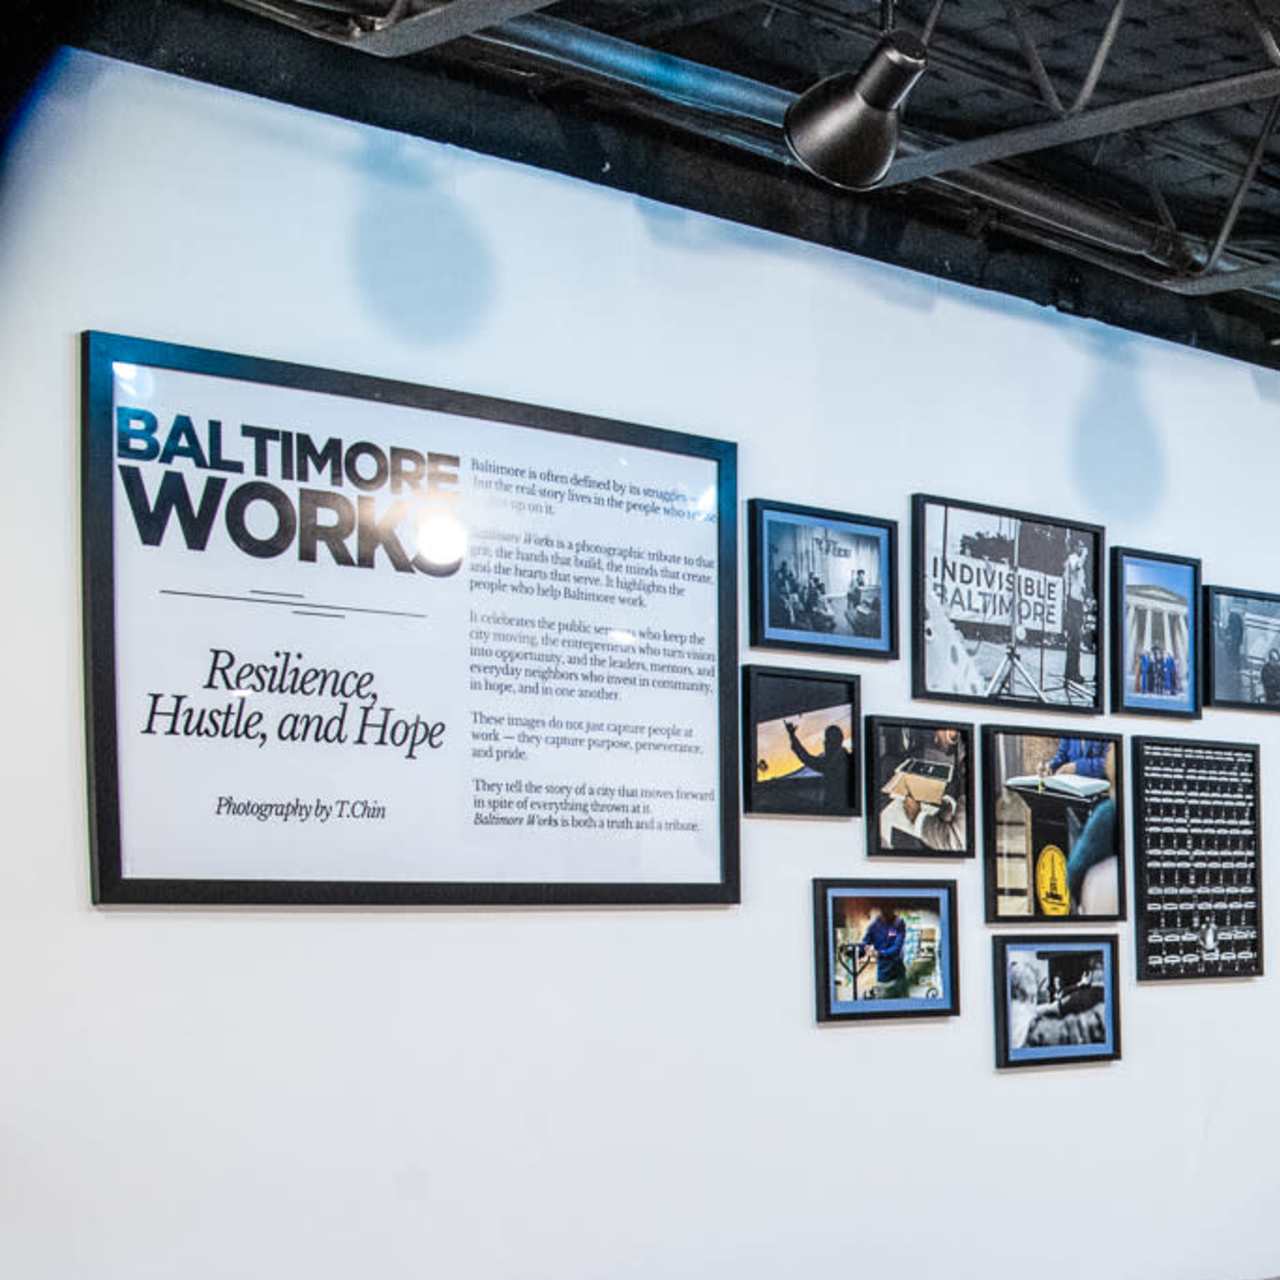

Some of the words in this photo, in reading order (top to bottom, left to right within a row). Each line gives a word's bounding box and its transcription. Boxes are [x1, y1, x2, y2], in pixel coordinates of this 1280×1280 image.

[116, 405, 461, 495] BALTIMORE
[528, 466, 537, 479] is
[540, 469, 568, 484] often
[570, 473, 611, 491] defined
[613, 480, 626, 496] by
[539, 488, 565, 504] story
[567, 488, 592, 504] lives
[593, 495, 604, 507] in
[607, 495, 624, 510] the
[626, 501, 661, 517] people
[663, 507, 685, 518] who
[515, 549, 549, 564] hands
[551, 551, 571, 566] that
[606, 560, 623, 574] the
[625, 564, 658, 577] minds
[660, 566, 681, 580] that
[575, 541, 644, 561] photographic
[648, 549, 681, 565] tribute
[684, 555, 694, 567] to
[695, 555, 715, 569] that
[469, 579, 507, 595] people
[510, 583, 535, 597] who
[537, 584, 561, 601] help
[564, 587, 616, 604] Baltimore
[494, 562, 512, 577] the
[515, 565, 548, 580] hearts
[550, 570, 571, 583] that
[616, 577, 667, 595] highlights
[669, 582, 686, 597] the
[932, 556, 1057, 602] INDIVISIBLE
[538, 616, 556, 631] the
[558, 619, 591, 635] public
[639, 627, 661, 641] who
[663, 630, 687, 646] keep
[690, 632, 705, 646] the
[541, 632, 559, 647] the
[639, 643, 661, 657] who
[663, 646, 686, 660] turn
[470, 646, 493, 657] into
[495, 648, 565, 666] opportunity,
[567, 653, 588, 666] and
[590, 655, 607, 668] the
[697, 665, 716, 678] and
[470, 663, 522, 680] everyday
[524, 667, 579, 682] neighbors
[580, 670, 605, 683] who
[607, 674, 637, 687] invest
[639, 677, 650, 688] in
[202, 648, 379, 706] Resilience,
[470, 680, 482, 691] in
[517, 682, 539, 695] and
[541, 685, 554, 697] in
[555, 687, 575, 698] one
[140, 692, 268, 748] Hustle,
[277, 702, 357, 746] and
[354, 705, 447, 759] Hope
[472, 710, 504, 725] These
[507, 716, 546, 730] images
[548, 715, 563, 729] do
[565, 720, 584, 731] not
[585, 720, 605, 734] just
[606, 722, 646, 737] capture
[648, 724, 682, 740] people
[684, 727, 694, 738] at
[472, 728, 499, 742] work
[517, 731, 541, 748] they
[544, 734, 584, 749] capture
[472, 745, 494, 759] and
[472, 778, 503, 796] They
[505, 779, 523, 793] tell
[525, 780, 543, 794] the
[544, 785, 571, 799] story
[574, 783, 587, 796] of
[588, 787, 596, 797] a
[596, 786, 616, 800] city
[618, 783, 639, 798] that
[215, 796, 313, 820] Photography
[313, 801, 333, 820] by
[336, 800, 386, 820] T.Chin
[473, 798, 485, 810] in
[487, 798, 514, 812] spite
[516, 796, 529, 810] of
[530, 799, 590, 815] everything
[591, 800, 629, 814] thrown
[631, 803, 641, 814] at
[473, 812, 524, 826] Baltimore
[561, 819, 569, 828] is
[571, 815, 598, 829] both
[598, 819, 605, 828] a
[607, 816, 633, 830] truth
[636, 818, 655, 830] and
